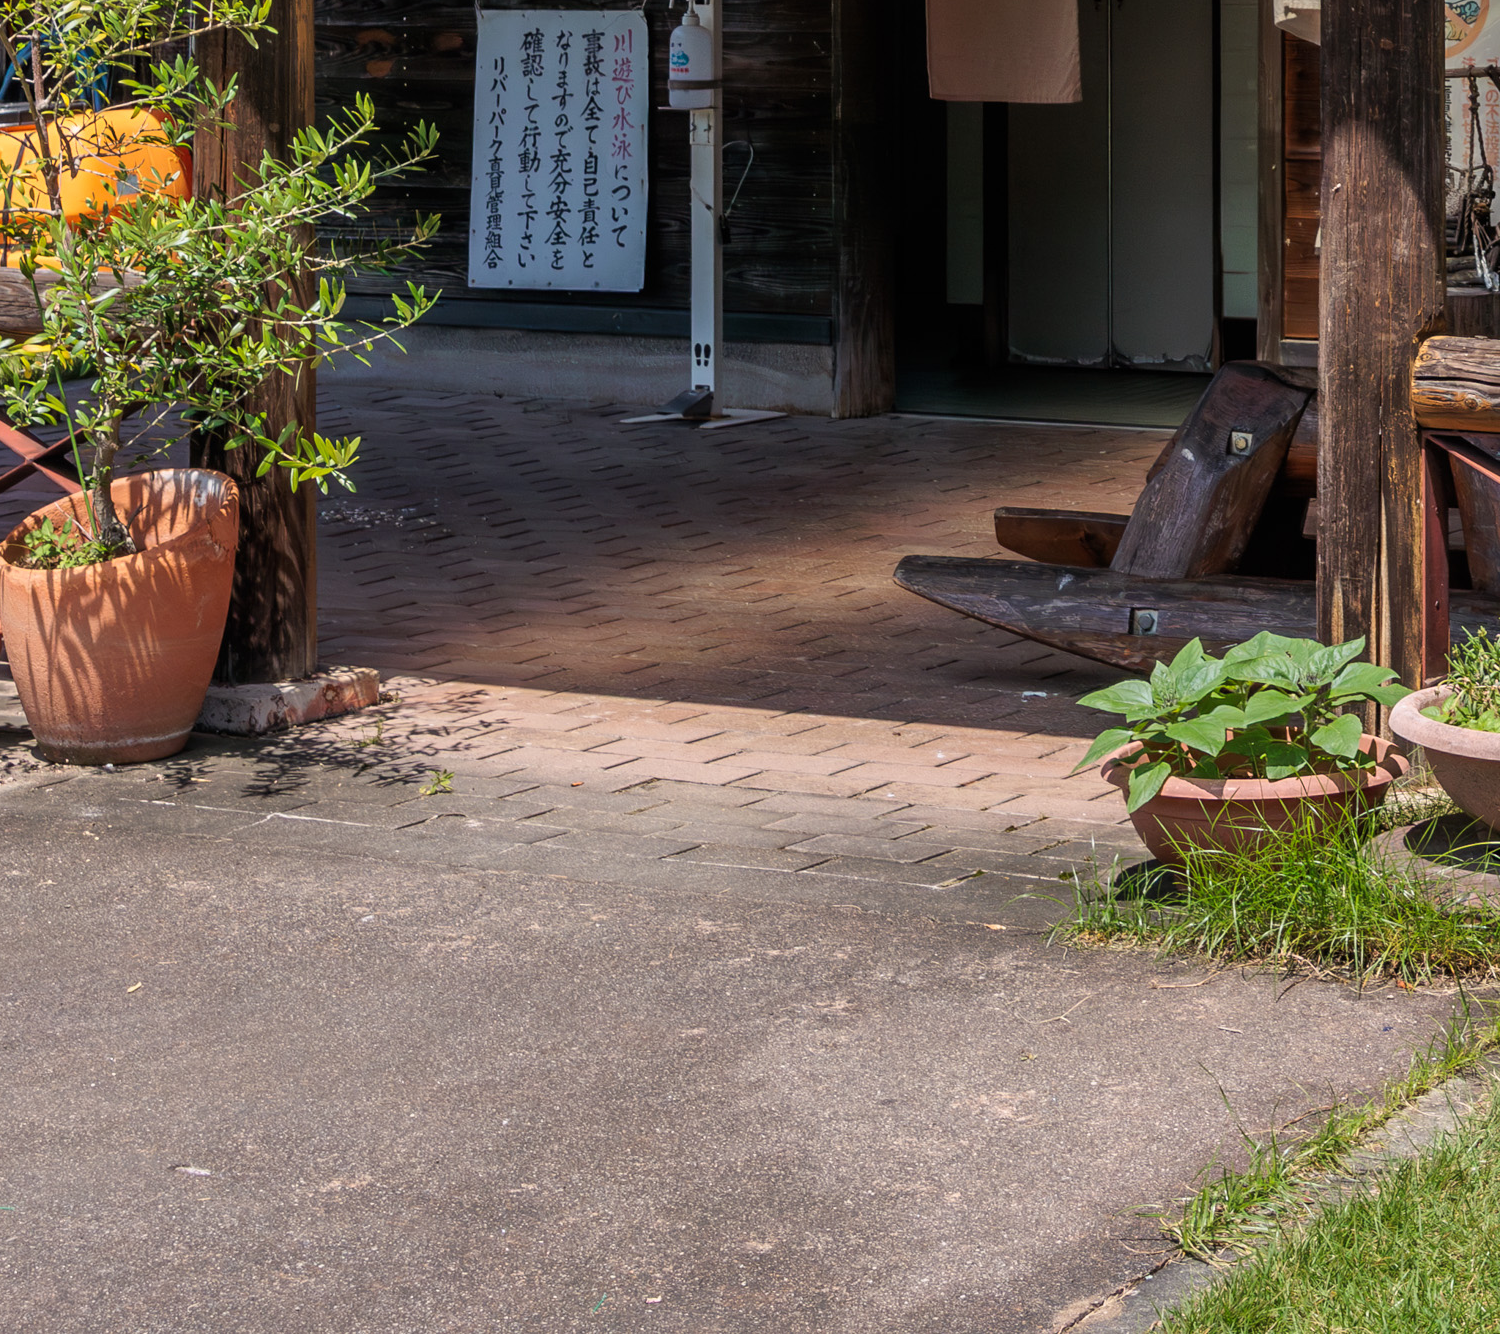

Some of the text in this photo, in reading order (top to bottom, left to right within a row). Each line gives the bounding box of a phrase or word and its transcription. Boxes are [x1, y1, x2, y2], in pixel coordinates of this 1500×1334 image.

[516, 27, 545, 268] 確認して行動して下さい
[544, 30, 574, 270] なりますので充分安全を
[577, 28, 606, 269] 事故は全て自己責任と
[611, 28, 634, 248] 川遊び水泳について
